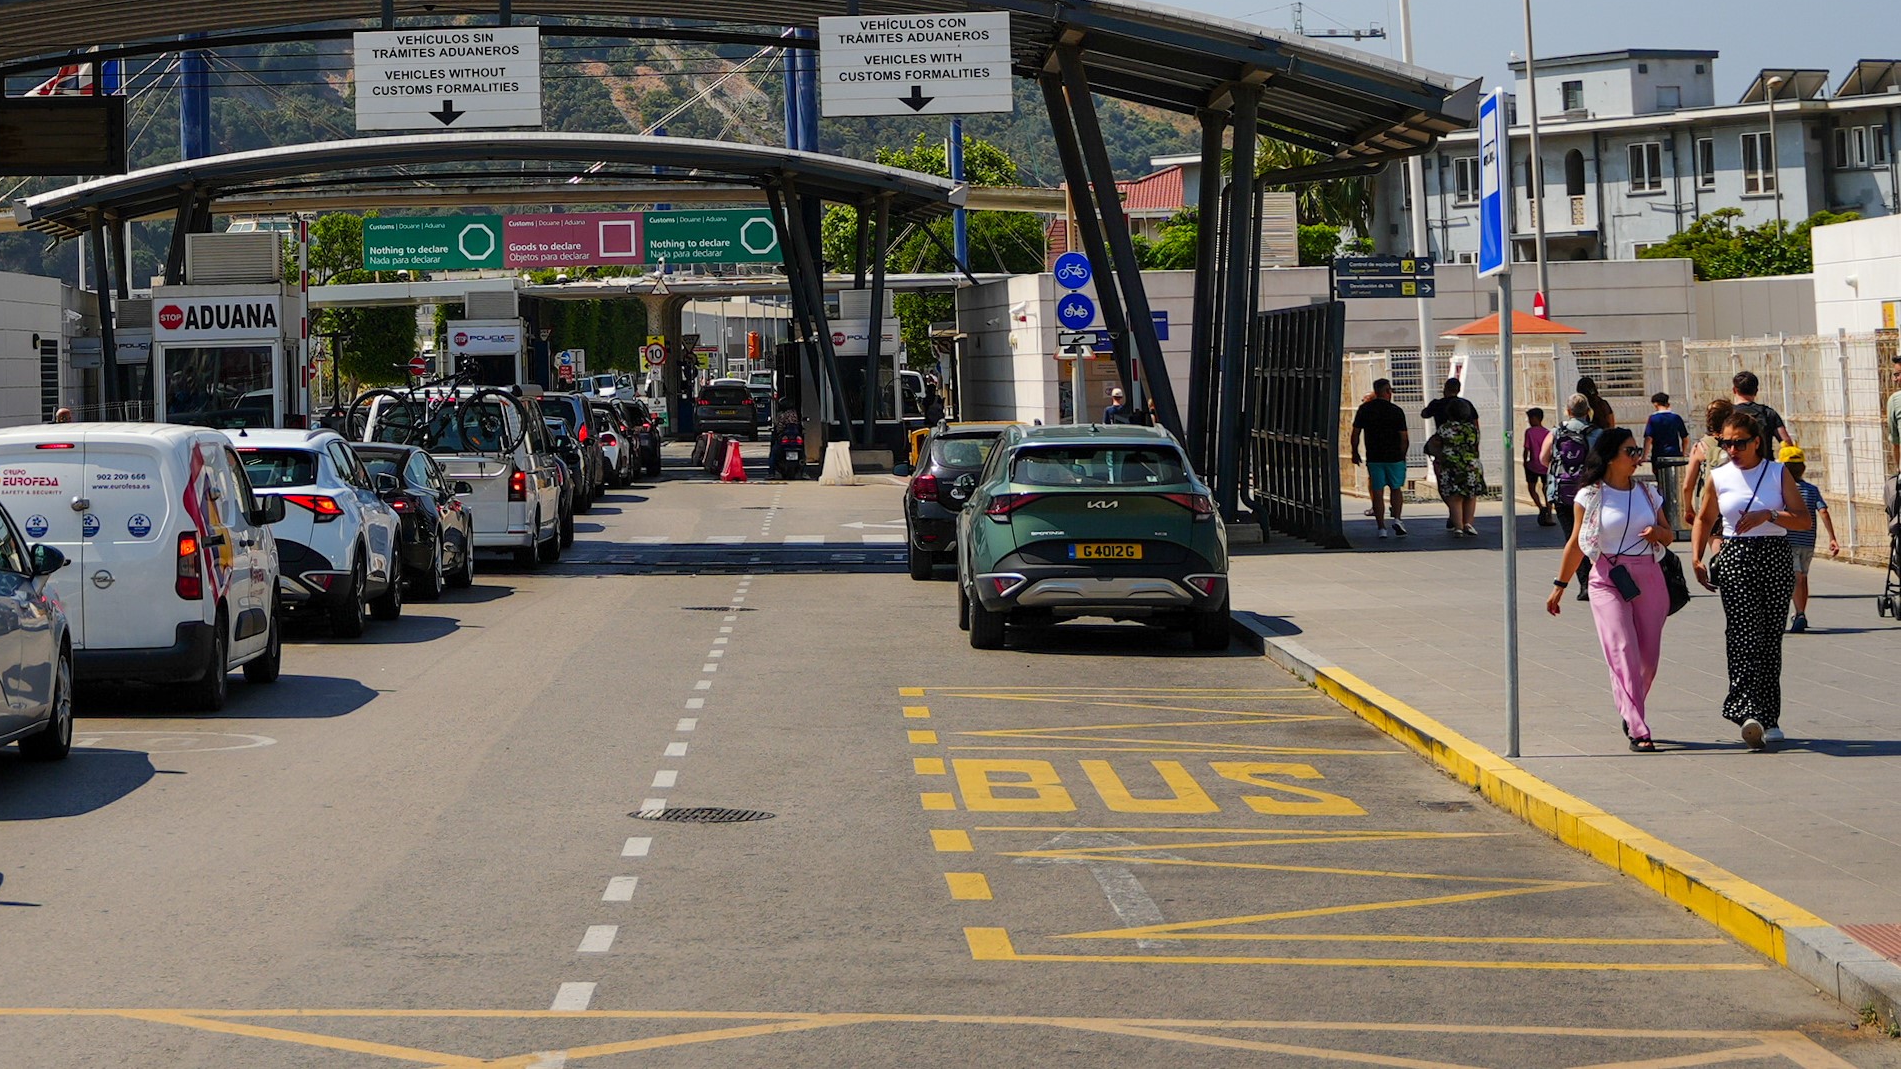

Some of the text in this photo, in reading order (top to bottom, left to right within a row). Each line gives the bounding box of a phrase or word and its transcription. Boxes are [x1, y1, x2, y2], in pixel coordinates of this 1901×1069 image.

[860, 18, 967, 31] VEHÍCULOS CON
[397, 33, 494, 46] VEHÍCULOS SIN
[838, 30, 990, 44] TRÁMITES ADUANEROS
[372, 45, 520, 59] TRÁMITES ADUANEROS
[864, 53, 963, 65] VEHICLES WITH
[385, 67, 507, 80] VEHICLES WITHOUT
[838, 67, 990, 82] CUSTOMS FORMALITIES
[372, 82, 520, 96] CUSTOMS FORMALITIES
[508, 220, 535, 228] Customs
[509, 241, 581, 251] Goods to declare
[650, 239, 731, 249] Nothing to declare
[369, 245, 449, 256] Nothing to declare
[650, 249, 723, 259] Nada para declarar
[369, 255, 441, 266] Nada para declarar
[509, 251, 590, 263] Objetos para declarar
[160, 303, 278, 330] STOP ADUANA
[648, 348, 662, 359] 10
[2, 476, 60, 487] EUROFESA
[96, 473, 112, 481] 902
[114, 473, 129, 481] 209
[1087, 500, 1119, 509] KIA
[1083, 545, 1092, 557] G
[1094, 545, 1123, 557] 4012
[1125, 545, 1135, 557] G
[951, 758, 1369, 817] BUS
